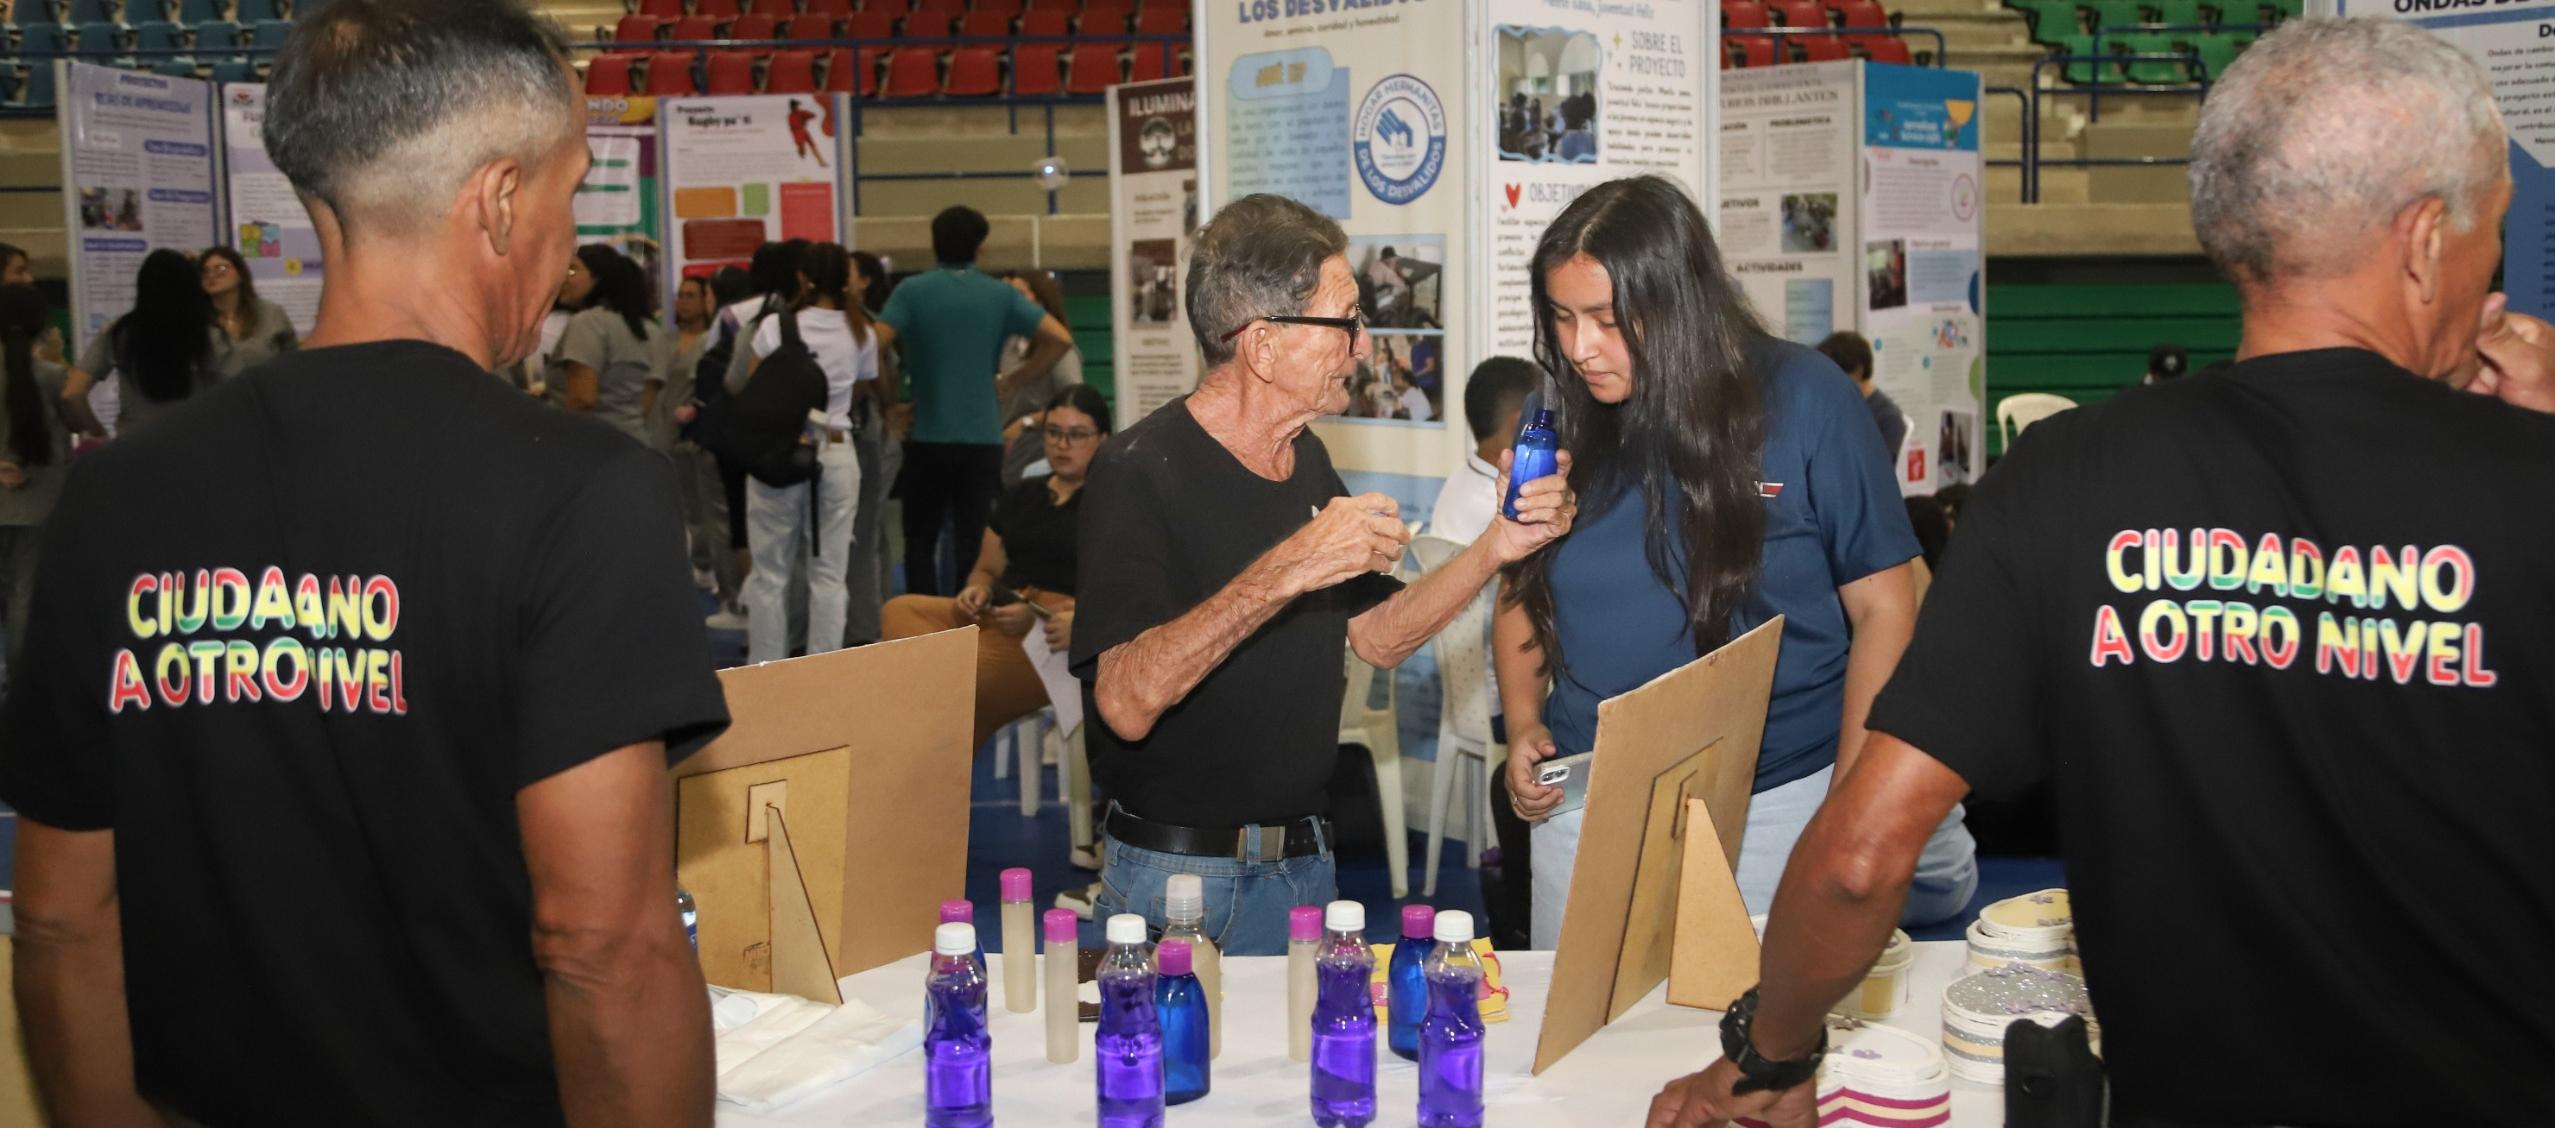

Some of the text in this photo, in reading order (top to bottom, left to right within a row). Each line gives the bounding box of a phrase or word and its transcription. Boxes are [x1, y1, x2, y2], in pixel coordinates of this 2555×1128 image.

[1238, 1, 1281, 24] LOS
[1629, 54, 1687, 79] PROYECTO
[1631, 31, 1684, 54] SOBRE EL
[587, 98, 629, 114] NDO
[1384, 79, 1444, 132] HERMANITAS
[1386, 141, 1443, 198] DESVALIDOS
[2106, 527, 2475, 612] CIUDADANO
[127, 564, 401, 641] CIUDAANO
[2090, 598, 2498, 687] A OTRO NIVEL
[109, 636, 407, 715] A OTRO IVEL
